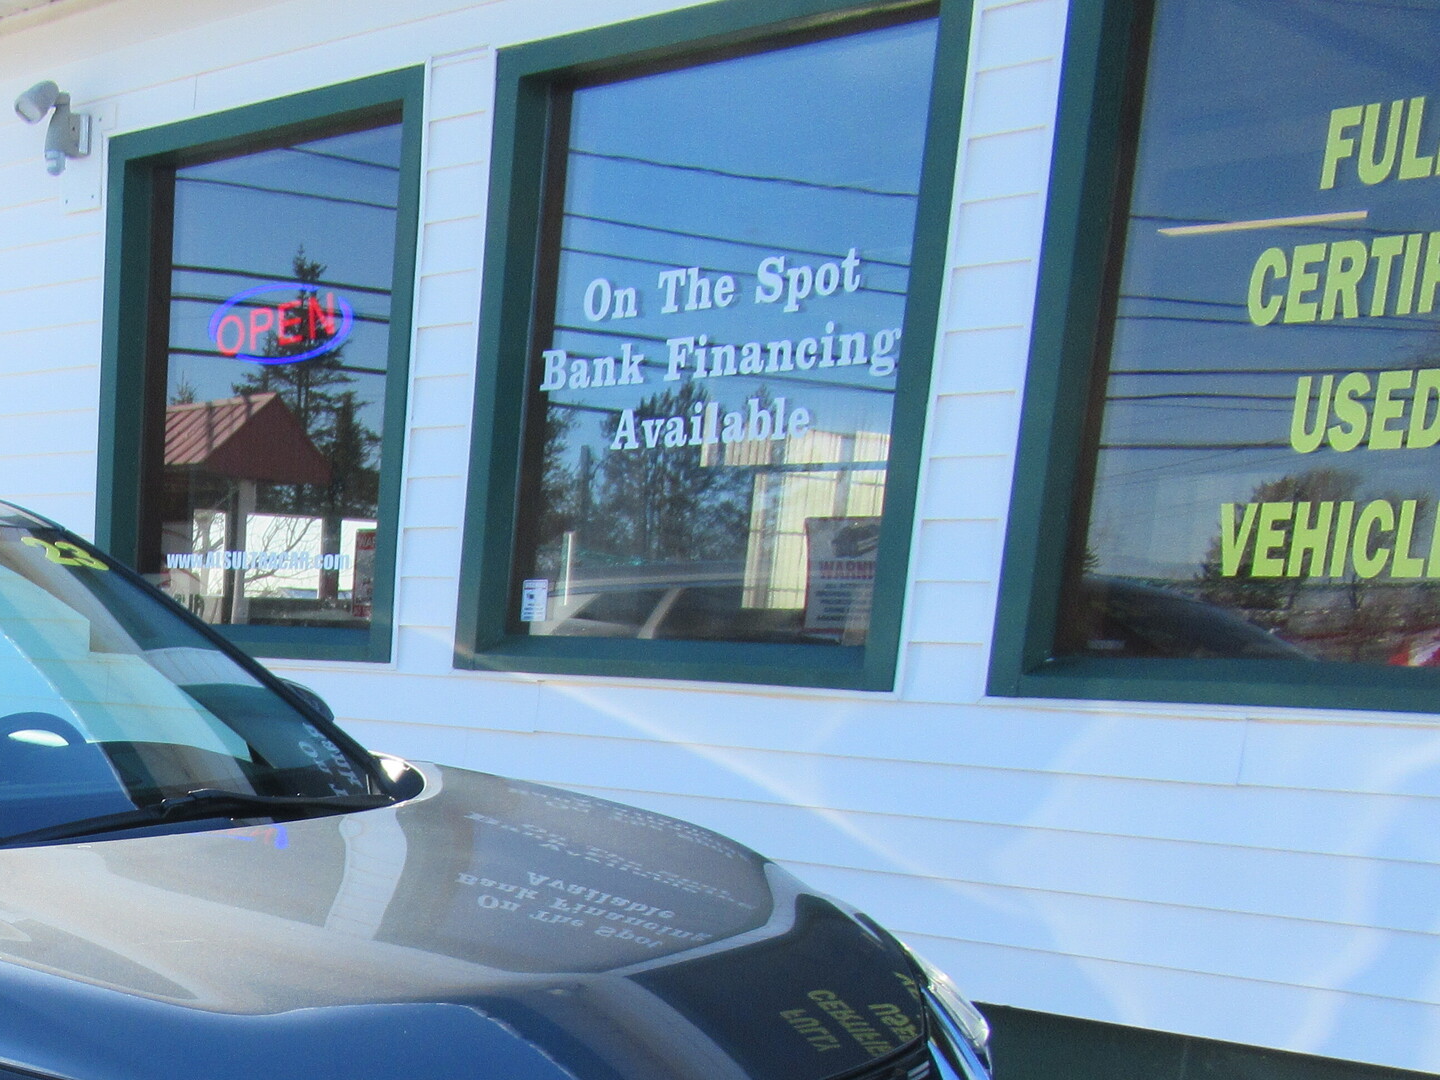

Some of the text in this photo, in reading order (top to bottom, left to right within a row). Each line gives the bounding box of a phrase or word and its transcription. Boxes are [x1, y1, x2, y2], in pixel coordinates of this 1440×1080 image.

[1318, 95, 1440, 191] FUL
[582, 247, 862, 322] On The Spot
[216, 292, 336, 357] OPEN
[539, 321, 902, 392] Bank Financing
[610, 397, 812, 451] Available
[1289, 369, 1440, 454] USED
